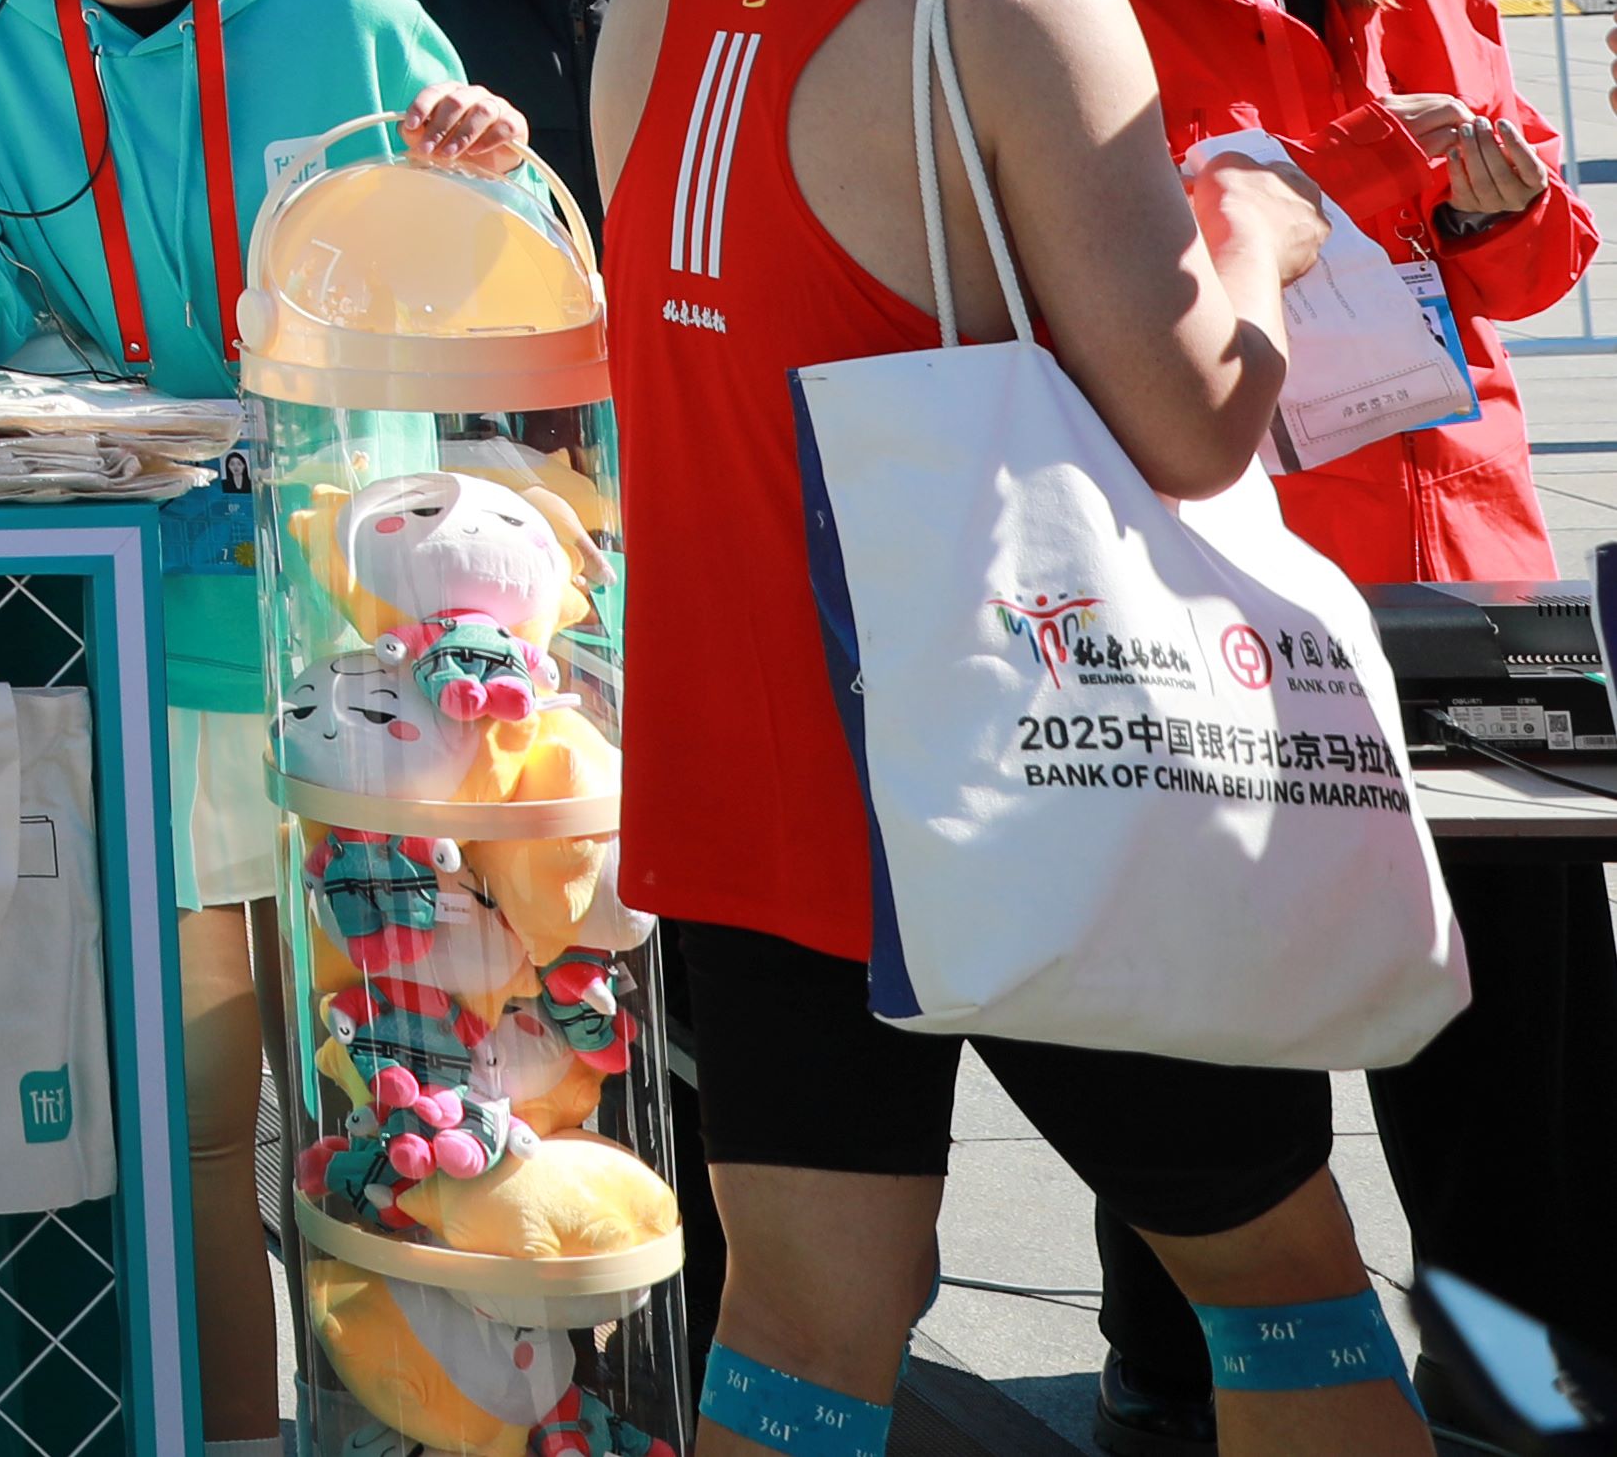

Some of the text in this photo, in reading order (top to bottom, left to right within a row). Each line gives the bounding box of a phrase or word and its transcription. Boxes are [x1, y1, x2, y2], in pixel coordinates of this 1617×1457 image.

[1079, 674, 1197, 691] BEIJING MARATHON
[1287, 677, 1347, 694] BANK OF
[1025, 763, 1411, 815] BANK OF CHINA BEIJING MARATHON
[726, 1369, 757, 1393] 361°
[814, 1404, 852, 1430] 361°
